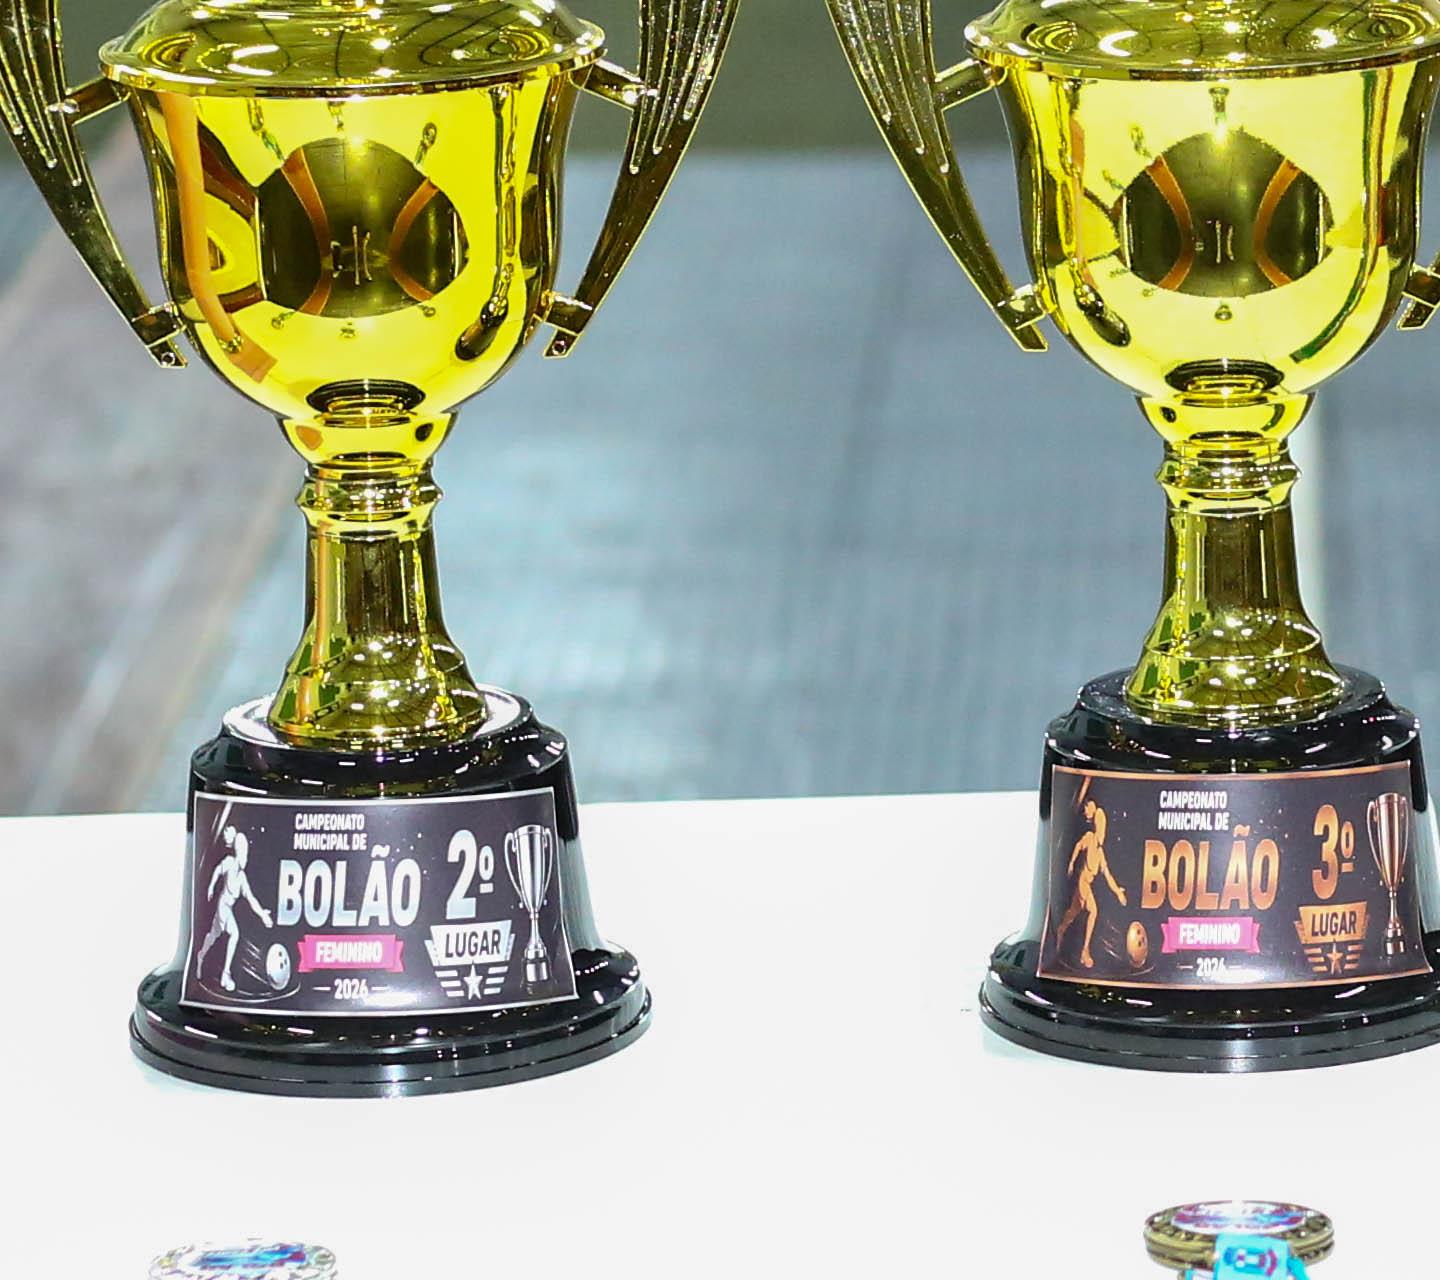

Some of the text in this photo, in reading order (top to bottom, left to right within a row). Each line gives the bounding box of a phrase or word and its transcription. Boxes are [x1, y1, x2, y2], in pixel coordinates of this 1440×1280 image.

[1159, 790, 1228, 809] CAMPEONATO
[295, 813, 365, 830] CAMPEONATO
[1158, 811, 1230, 831] MUNICIPAL DE
[293, 833, 367, 851] MUNICIPAL DE
[1141, 825, 1280, 911] BOLÃO
[277, 845, 423, 928] BOLÃO
[1179, 923, 1241, 946] FEMININO
[1310, 911, 1357, 937] LUGAR
[315, 940, 384, 964] FEMININO
[445, 930, 501, 958] LUGAR
[1196, 958, 1227, 977] 2026
[334, 979, 369, 999] 2026
